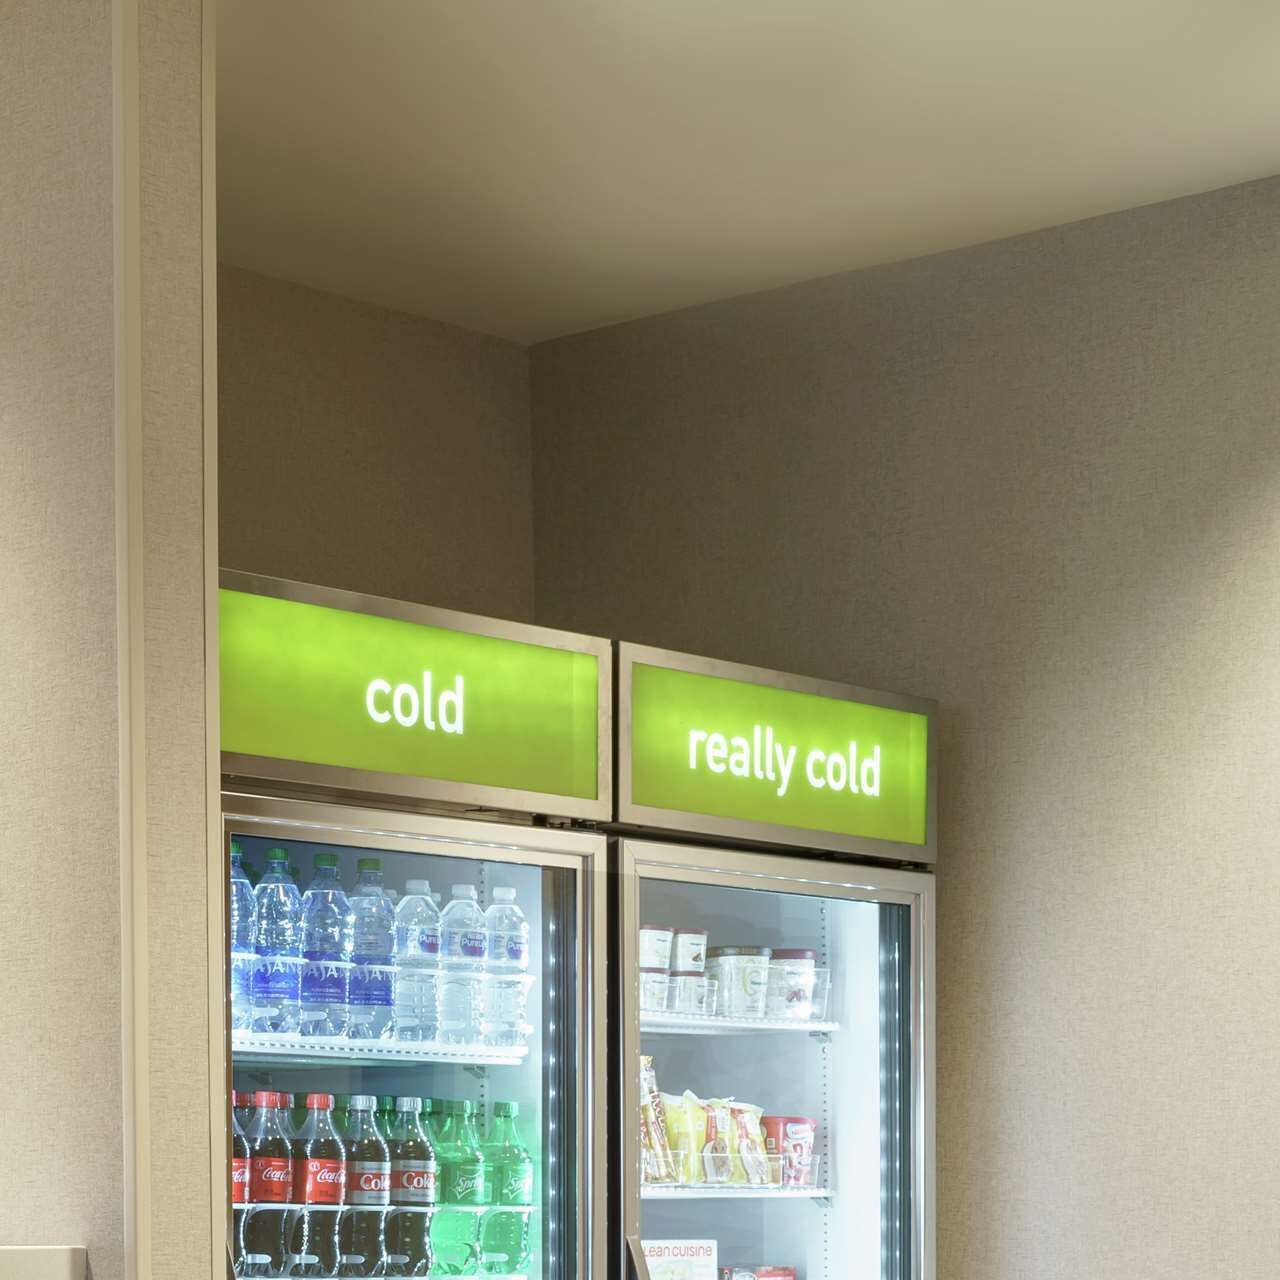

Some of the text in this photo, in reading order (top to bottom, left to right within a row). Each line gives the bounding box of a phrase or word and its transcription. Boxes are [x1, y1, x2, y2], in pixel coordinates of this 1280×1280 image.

[365, 670, 464, 735] cold
[687, 722, 881, 798] really cold
